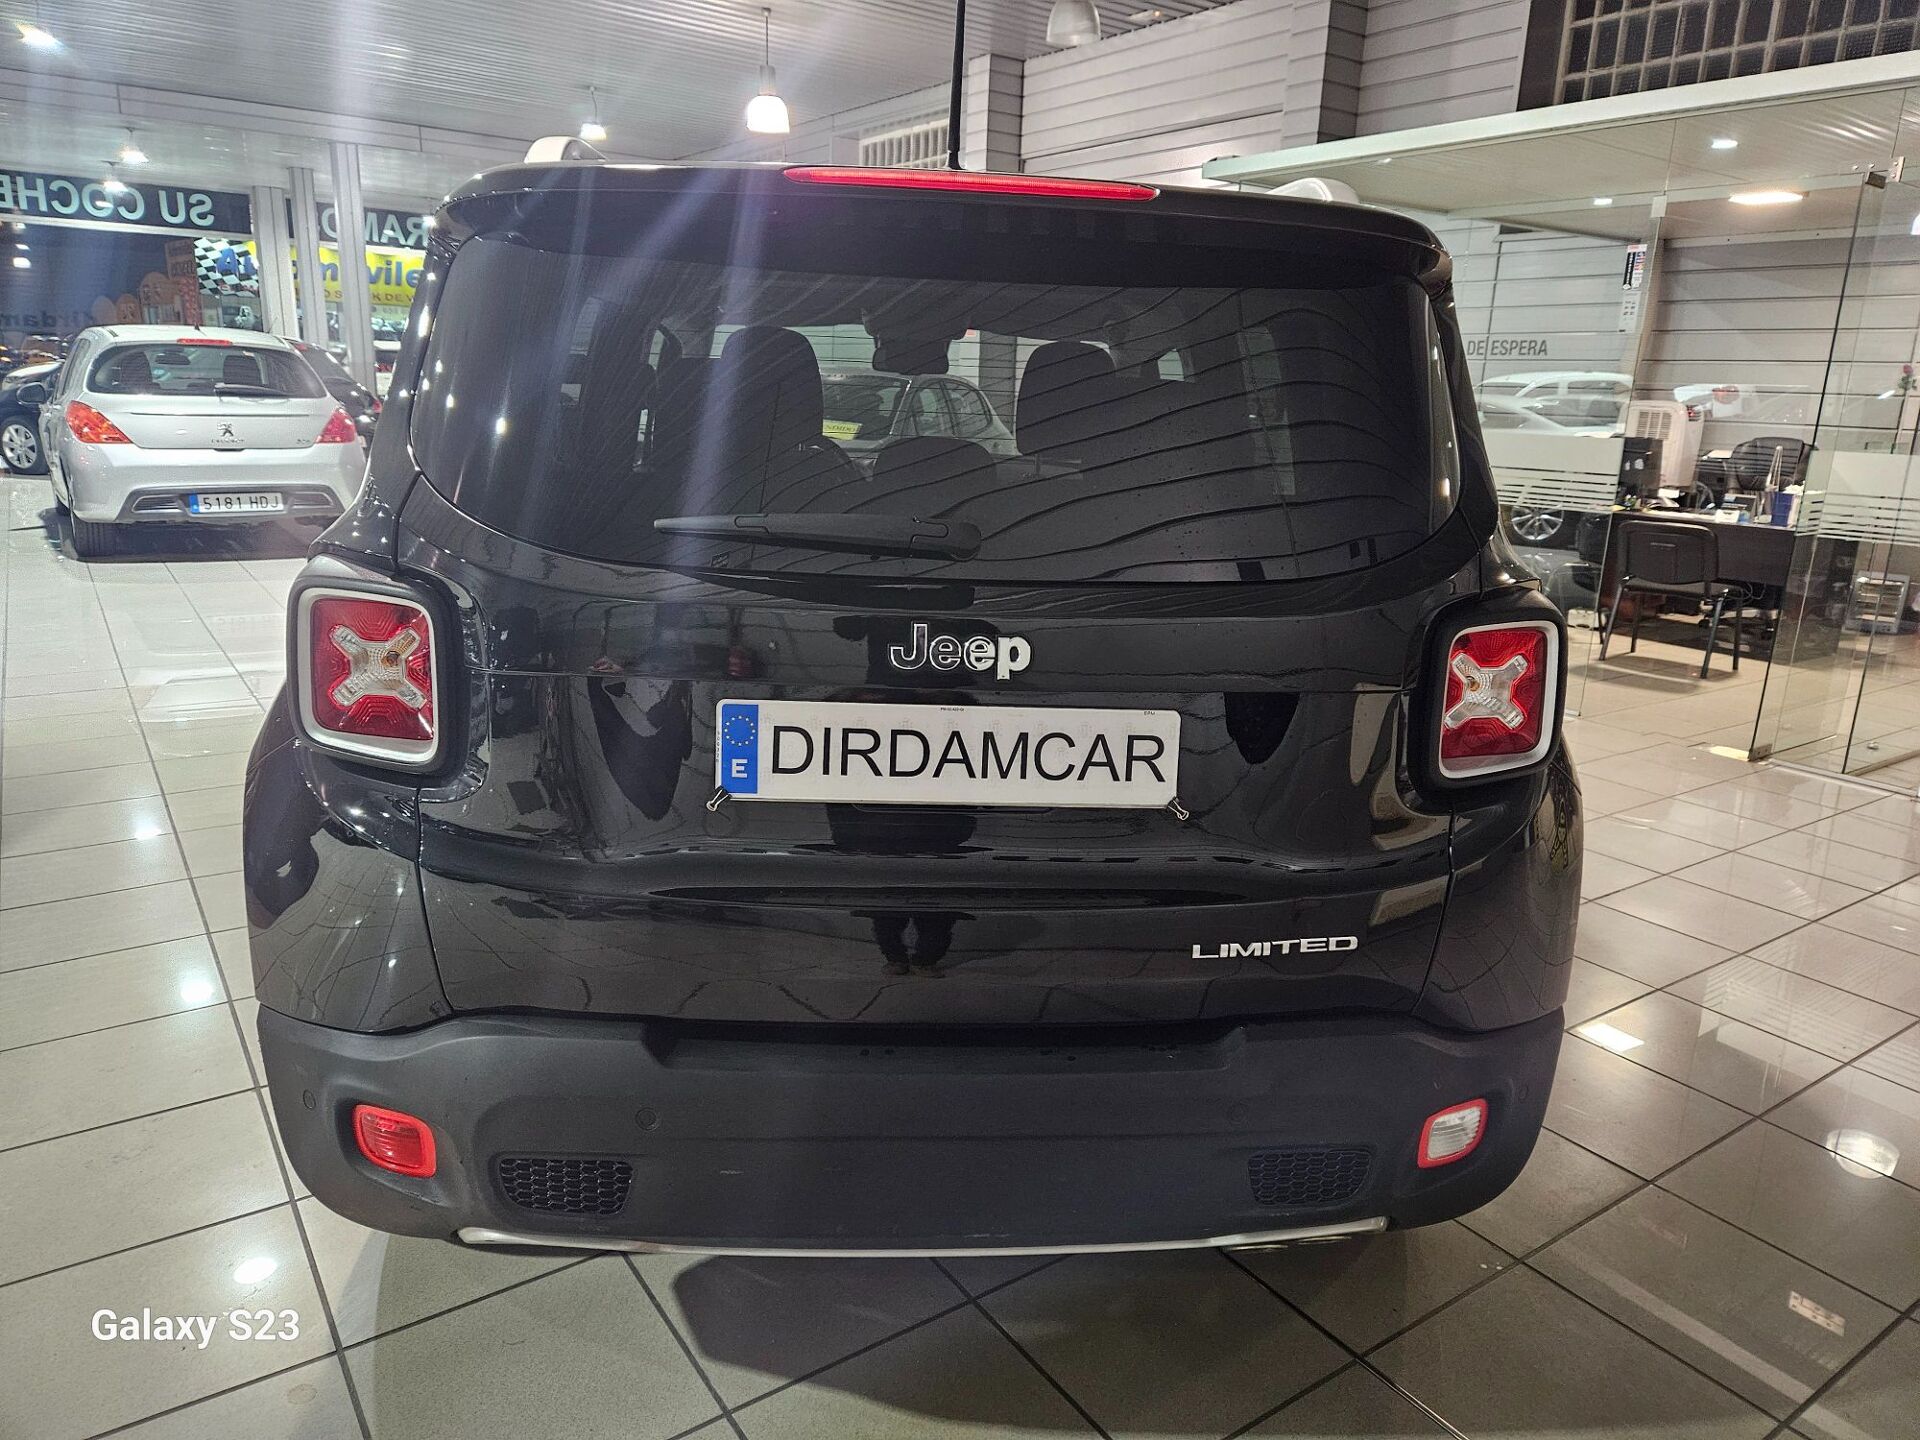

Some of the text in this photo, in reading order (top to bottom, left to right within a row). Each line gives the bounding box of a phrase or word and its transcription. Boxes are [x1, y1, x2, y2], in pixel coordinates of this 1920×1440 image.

[1467, 340, 1548, 356] DE ESPERA
[203, 496, 242, 511] 5181
[250, 494, 279, 510] HDJ
[890, 623, 1031, 680] Jeep
[772, 725, 1166, 782] DIRDAMCAR
[731, 758, 748, 778] E
[1192, 936, 1359, 959] LIMITED
